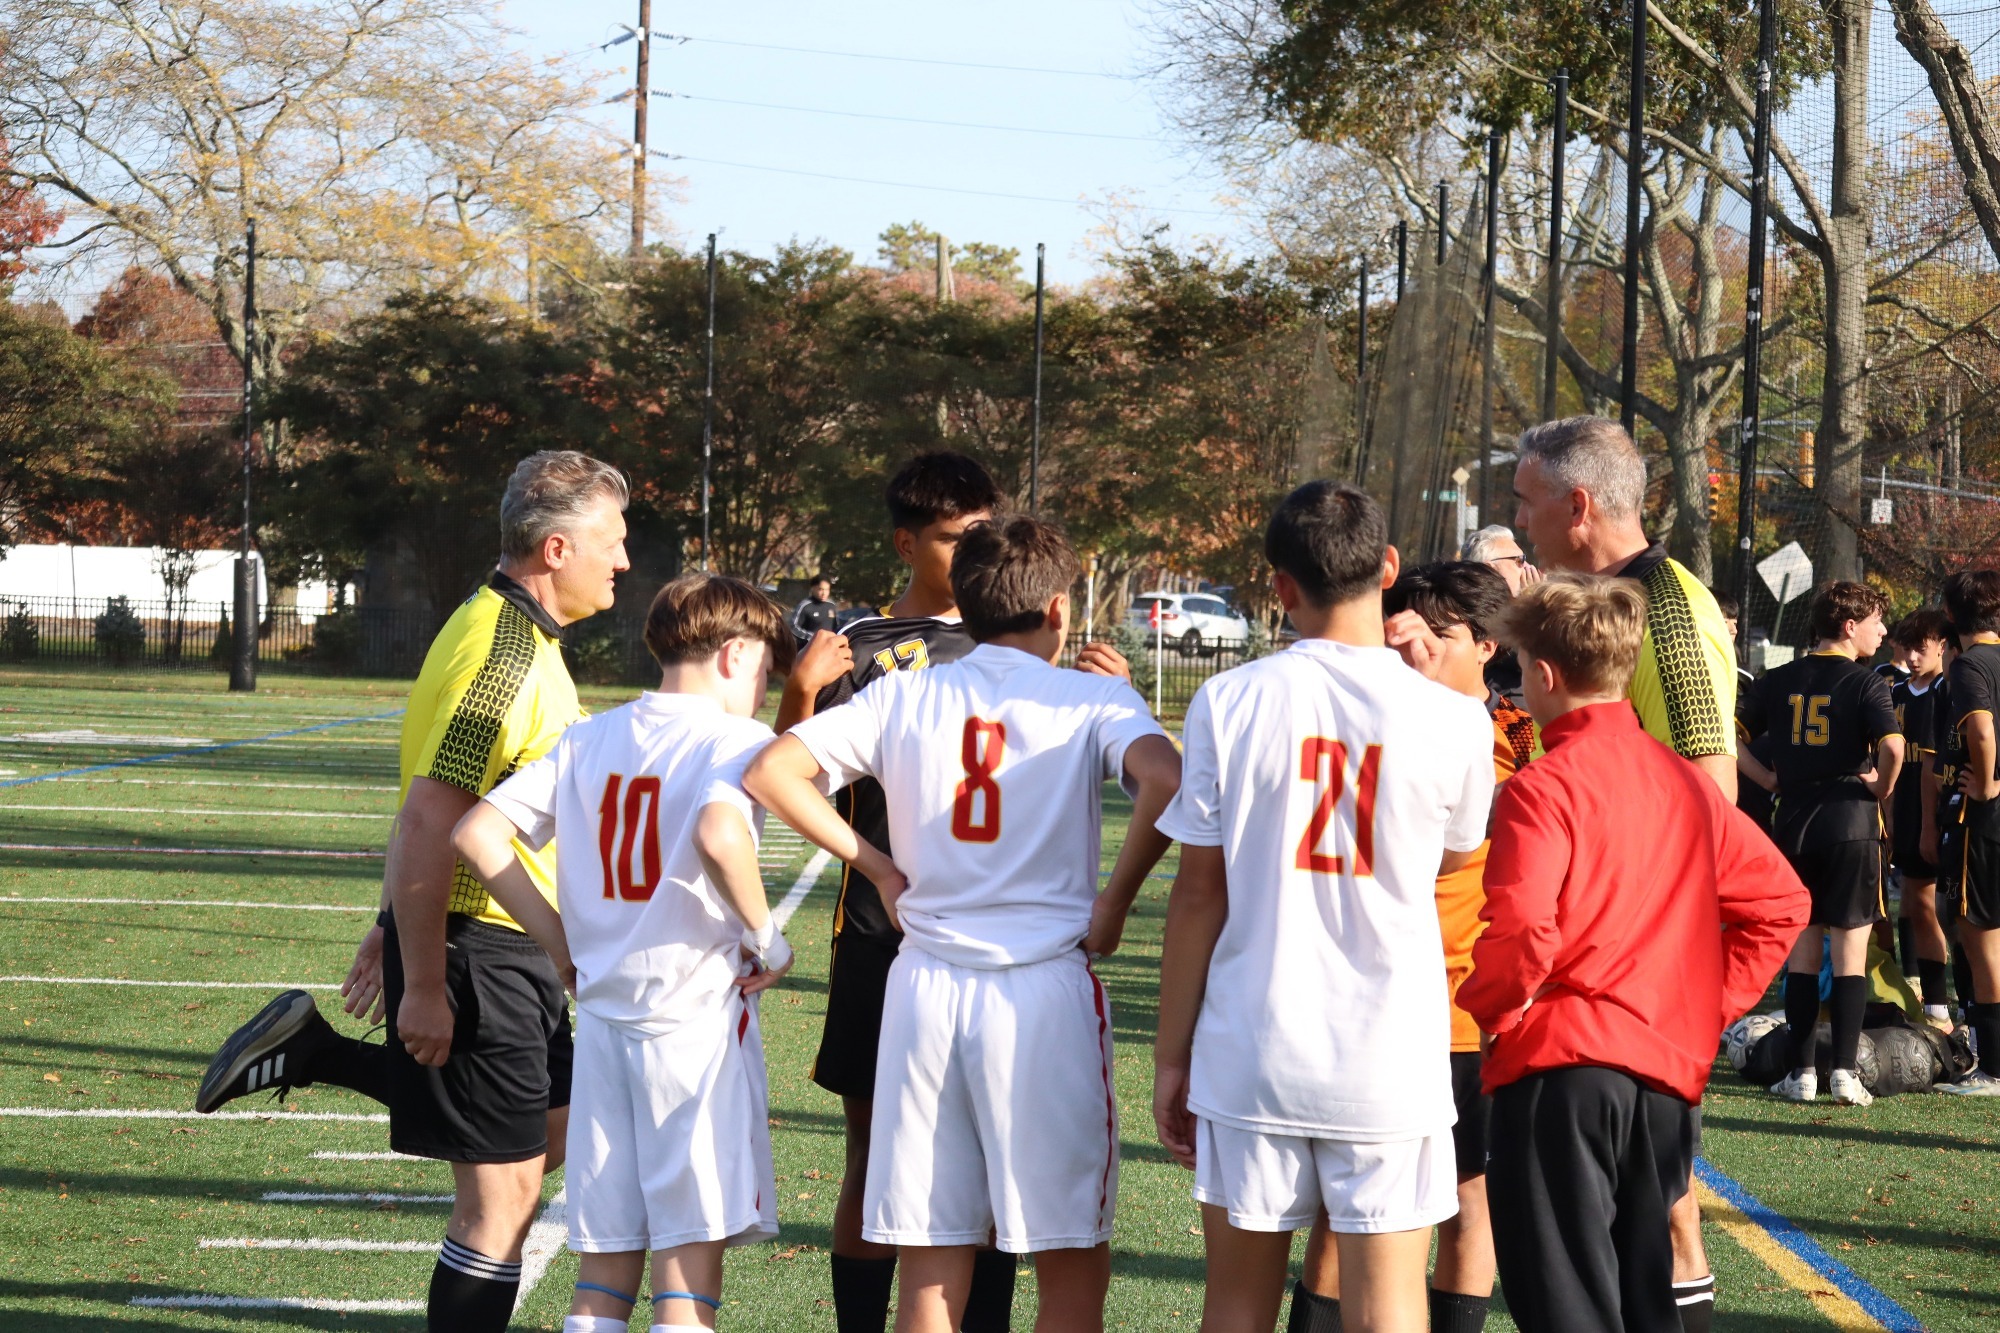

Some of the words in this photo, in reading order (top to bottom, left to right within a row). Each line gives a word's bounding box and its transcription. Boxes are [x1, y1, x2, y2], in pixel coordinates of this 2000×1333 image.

[950, 714, 1006, 845] 8
[1788, 693, 1831, 747] 15
[597, 772, 663, 903] 10
[1294, 735, 1383, 879] 21
